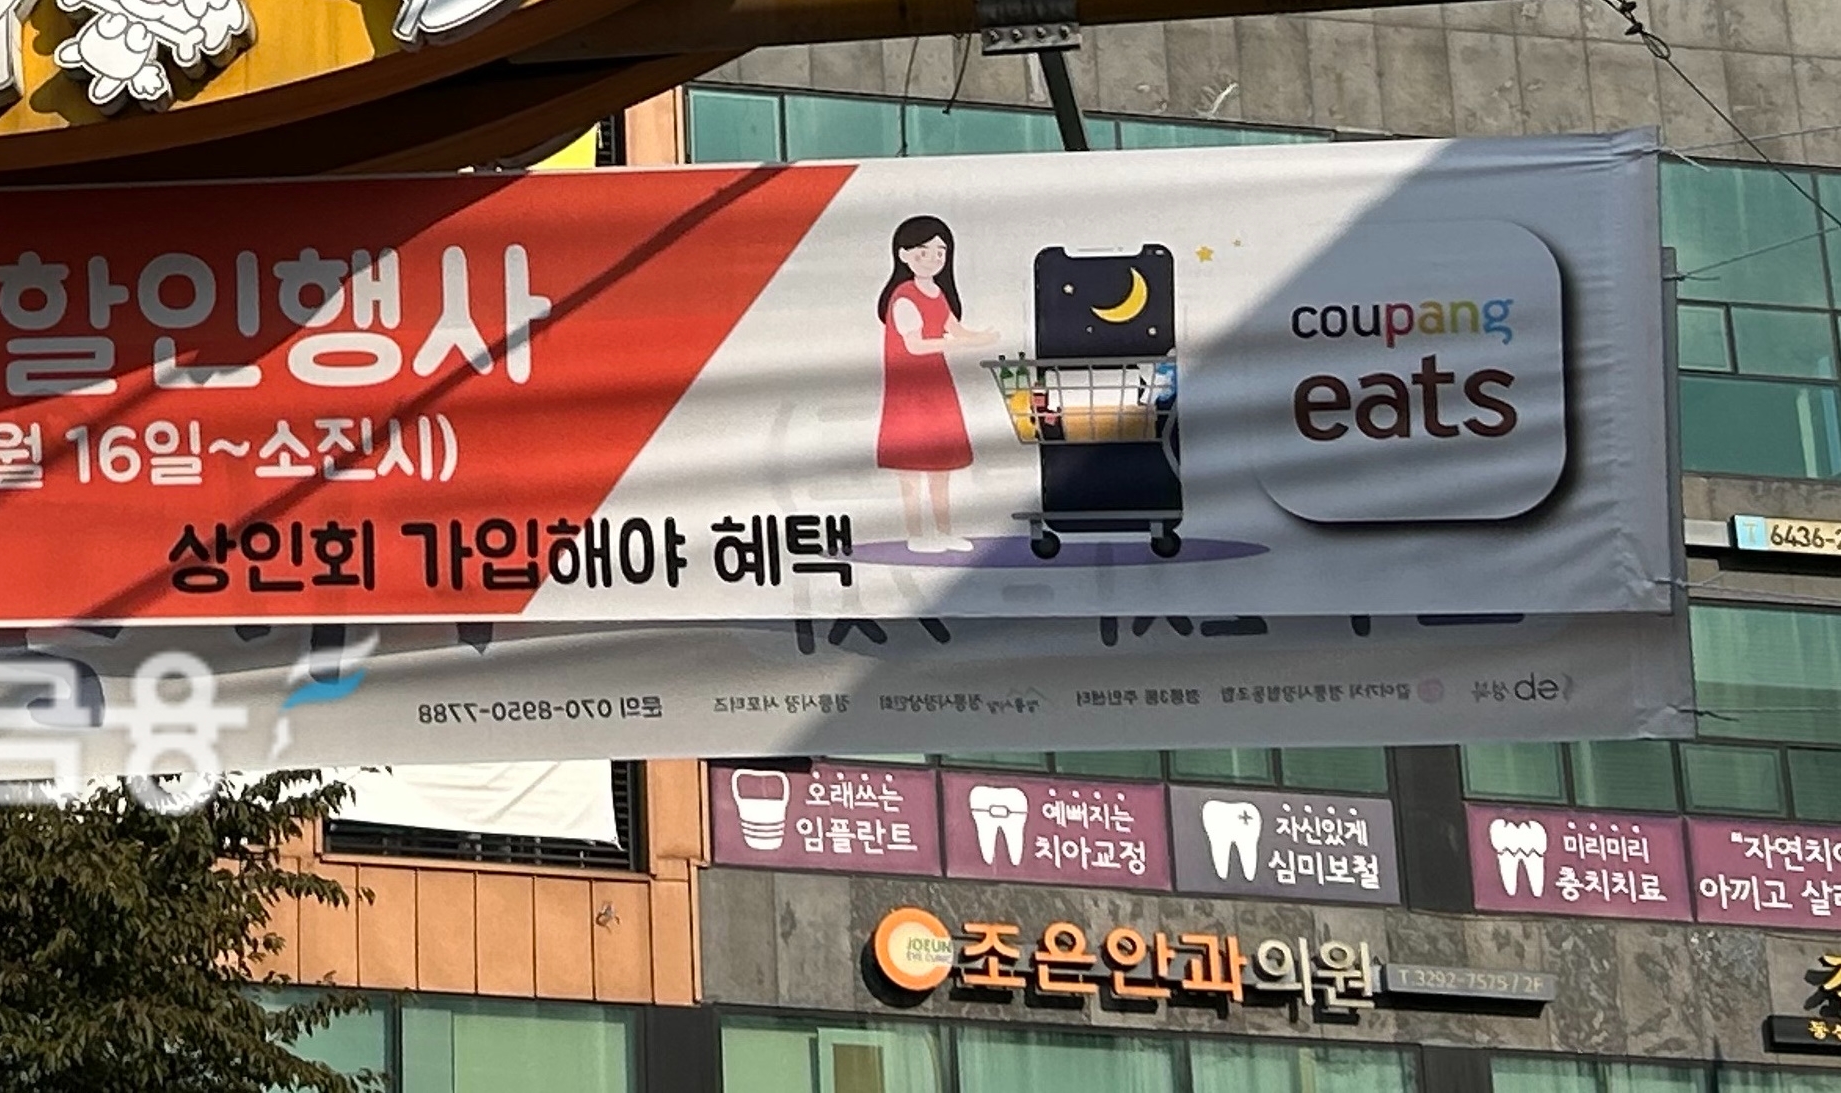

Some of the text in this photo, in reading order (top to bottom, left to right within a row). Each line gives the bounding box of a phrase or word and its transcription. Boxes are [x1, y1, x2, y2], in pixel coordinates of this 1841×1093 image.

[1291, 296, 1516, 345] coupang
[1291, 354, 1518, 444] eats
[66, 413, 459, 486] 16일~소진시)
[167, 510, 856, 594] 상인회 가입해야 혜택
[805, 778, 904, 813] 오래쓰는
[796, 816, 919, 856] 임플란트
[1275, 813, 1369, 848] 자신있게
[1562, 832, 1651, 865] 미리미리
[1033, 837, 1148, 876] 치아교정
[1268, 849, 1383, 891] 심미보철
[1554, 865, 1668, 903] 충치치료
[1699, 873, 1793, 912] 아끼고
[961, 921, 1375, 1007] 조은안과의원
